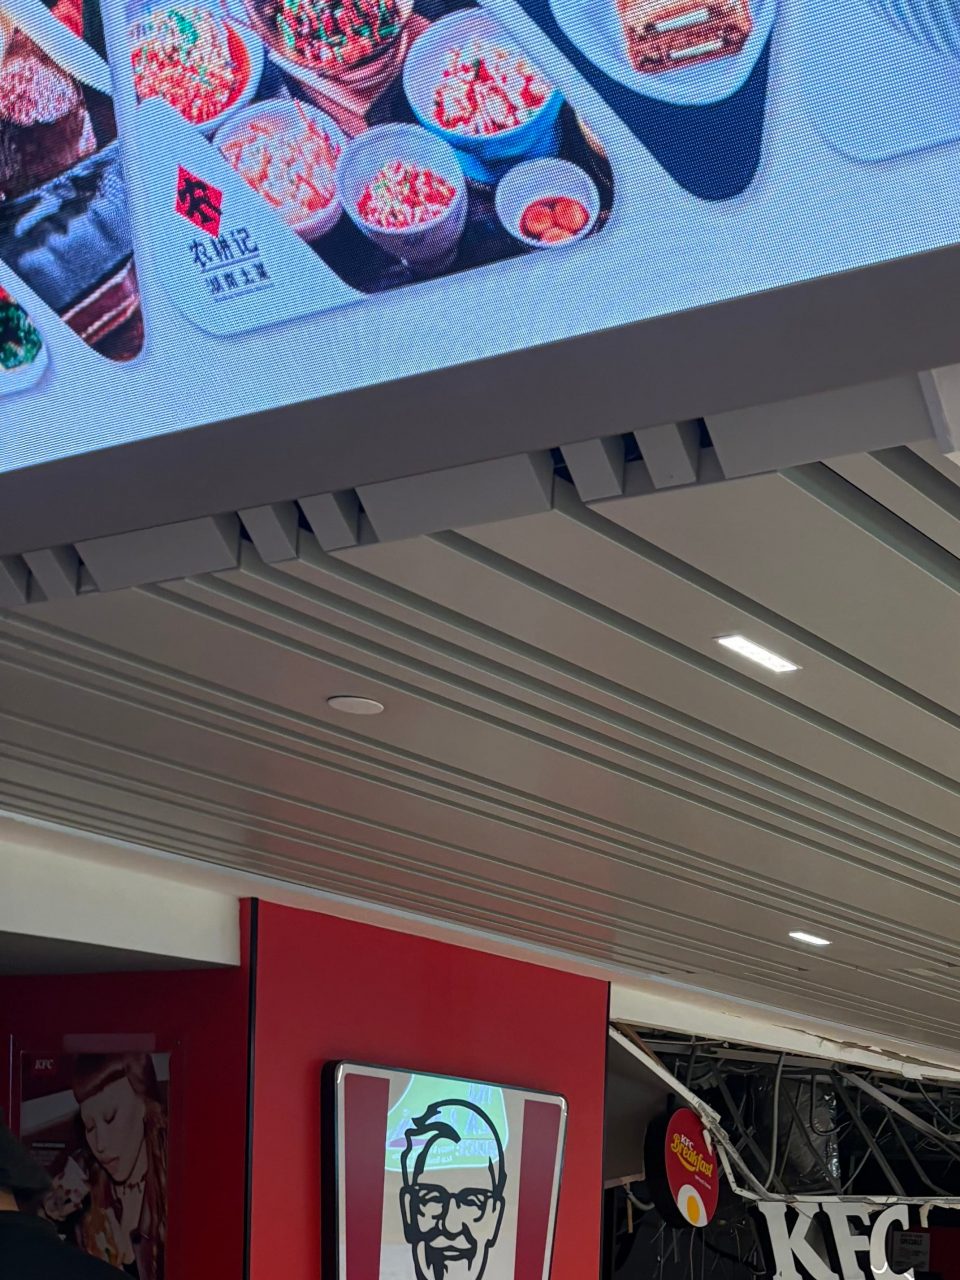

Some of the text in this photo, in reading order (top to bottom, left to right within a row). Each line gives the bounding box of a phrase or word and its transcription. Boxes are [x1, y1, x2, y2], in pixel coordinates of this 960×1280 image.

[35, 1059, 54, 1070] KFC
[681, 1134, 694, 1151] KFC
[671, 1133, 713, 1178] Breakfast
